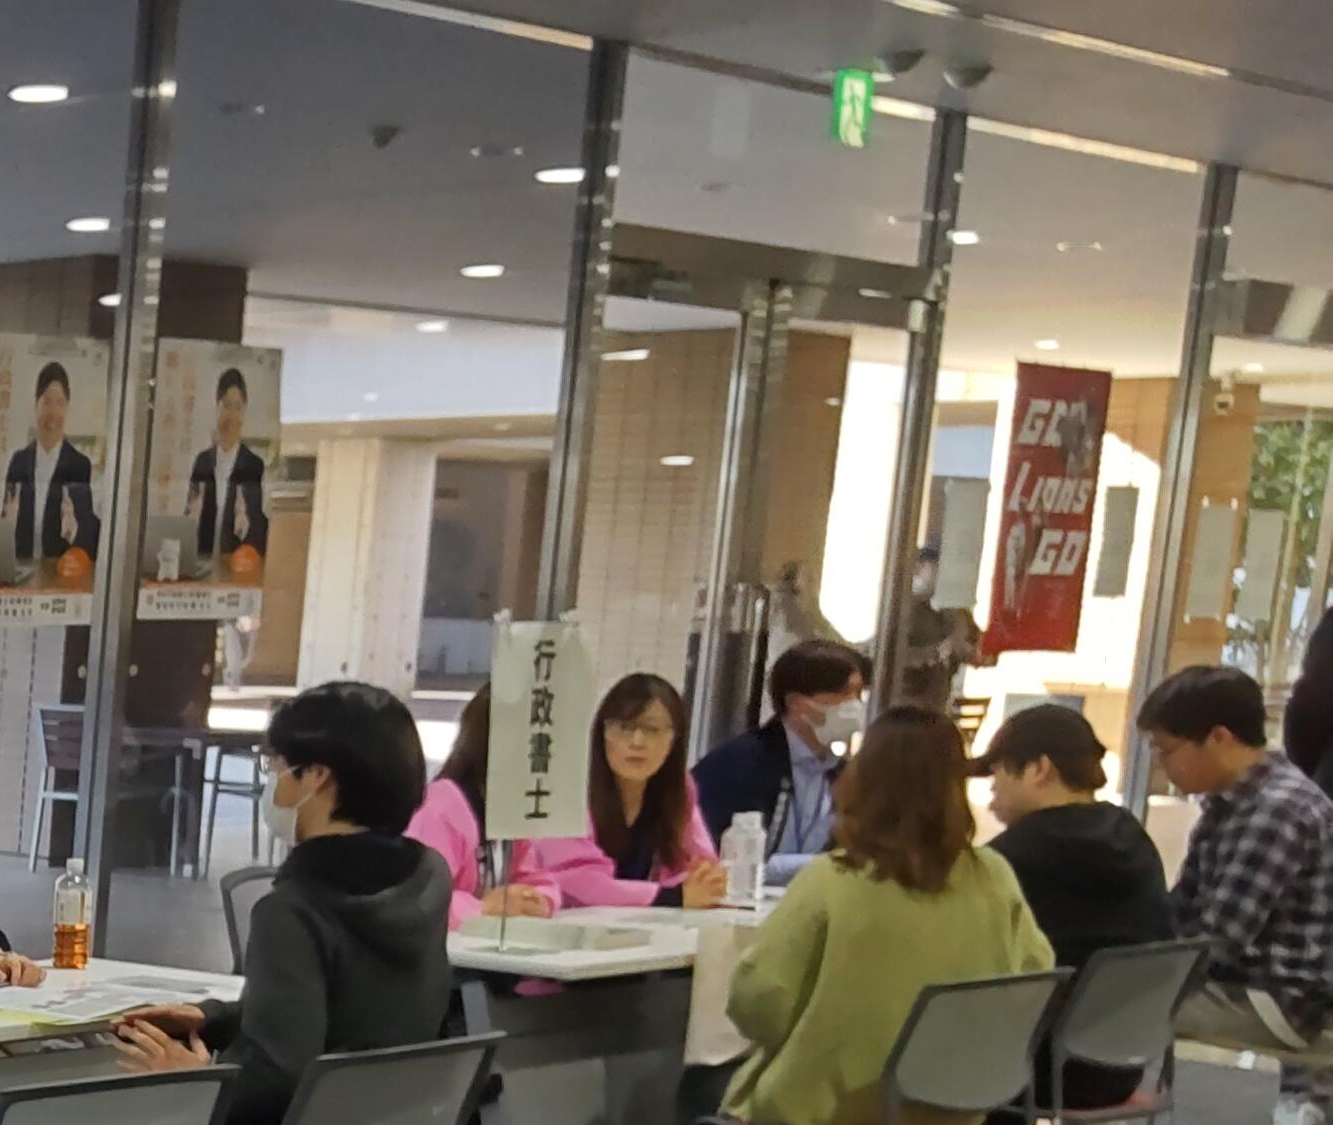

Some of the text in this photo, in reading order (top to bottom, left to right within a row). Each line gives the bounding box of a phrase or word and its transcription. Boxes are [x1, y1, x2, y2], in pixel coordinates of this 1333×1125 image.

[1028, 528, 1087, 576] GO
[524, 639, 557, 821] 行政書士
